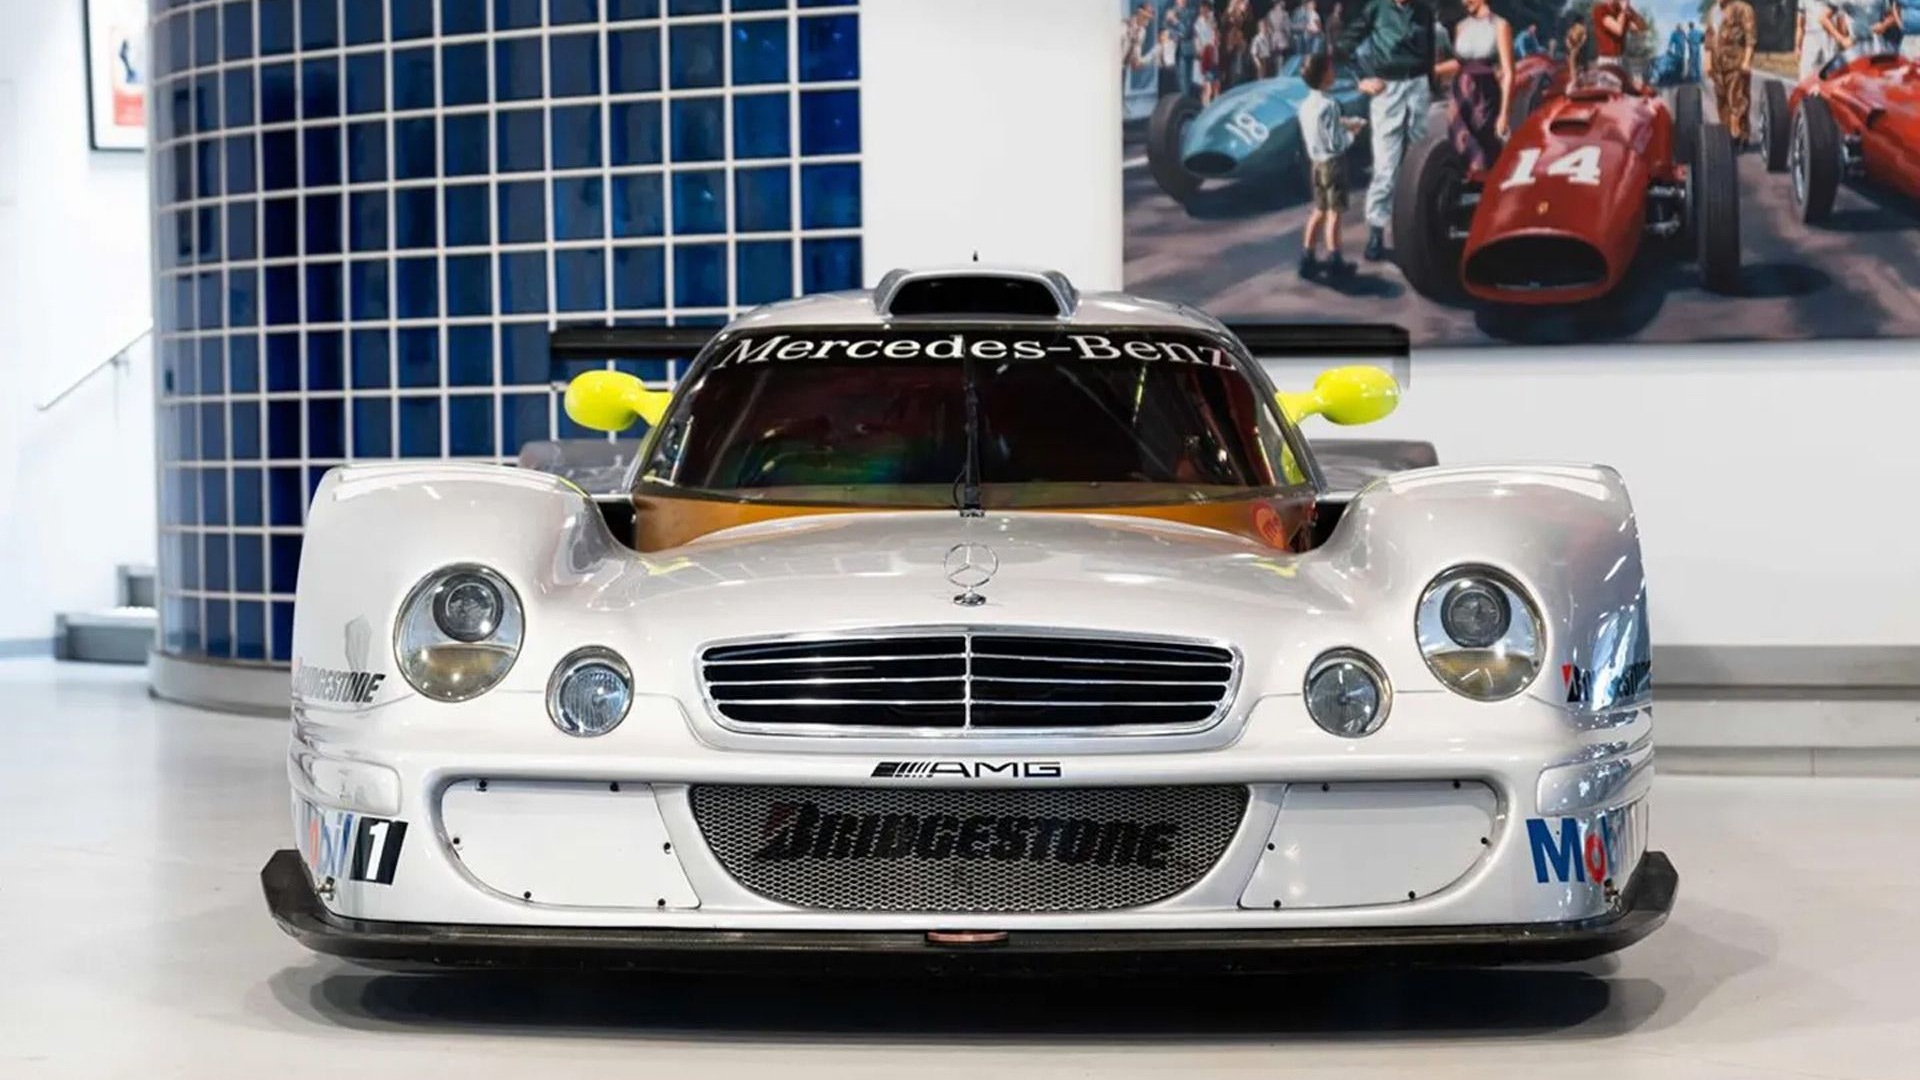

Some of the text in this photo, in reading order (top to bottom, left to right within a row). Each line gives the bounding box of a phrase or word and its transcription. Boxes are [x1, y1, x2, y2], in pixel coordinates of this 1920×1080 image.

[1225, 112, 1270, 147] 18
[1501, 146, 1601, 188] 14
[713, 334, 1238, 371] Mercedes-Benz
[365, 821, 390, 880] 1
[754, 802, 1178, 868] BRIDGESTONE
